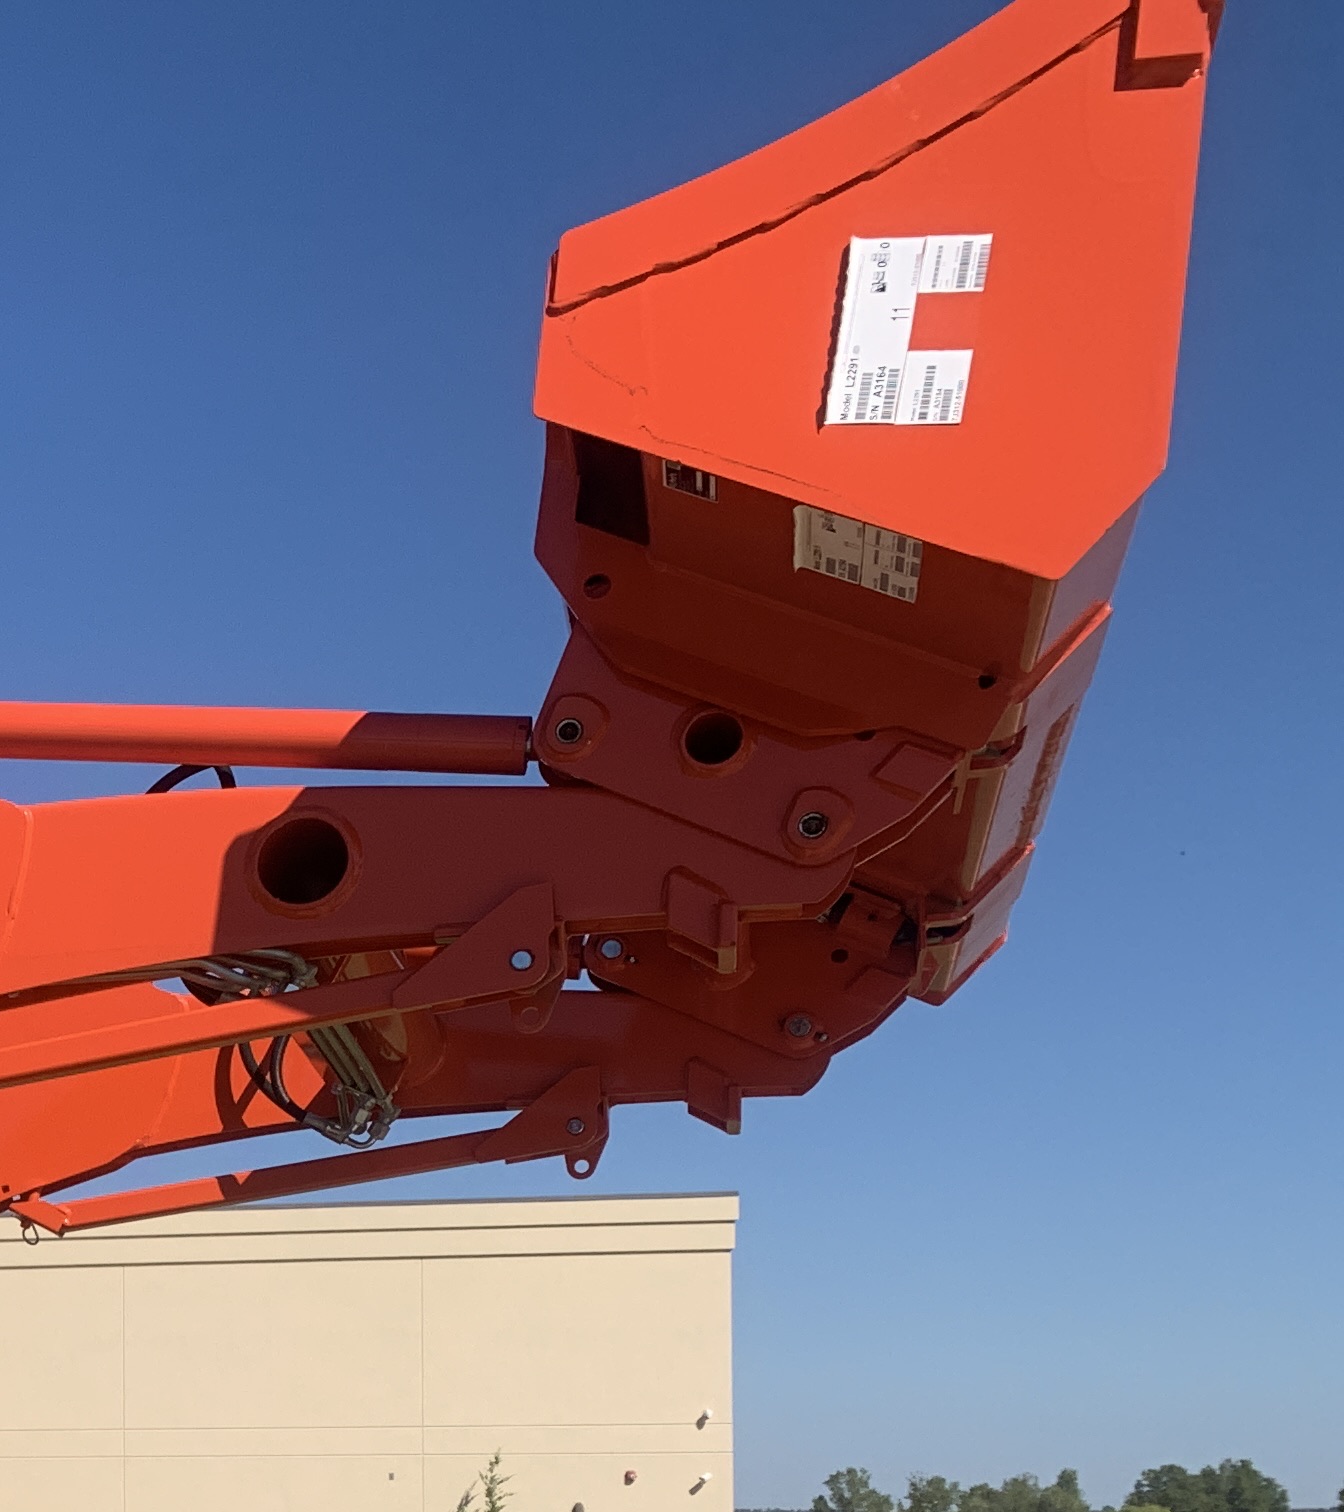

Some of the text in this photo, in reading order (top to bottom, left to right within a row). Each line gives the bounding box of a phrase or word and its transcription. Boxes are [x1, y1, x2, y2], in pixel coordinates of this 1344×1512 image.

[839, 357, 859, 421] Model L2291
[873, 366, 887, 397] A3164
